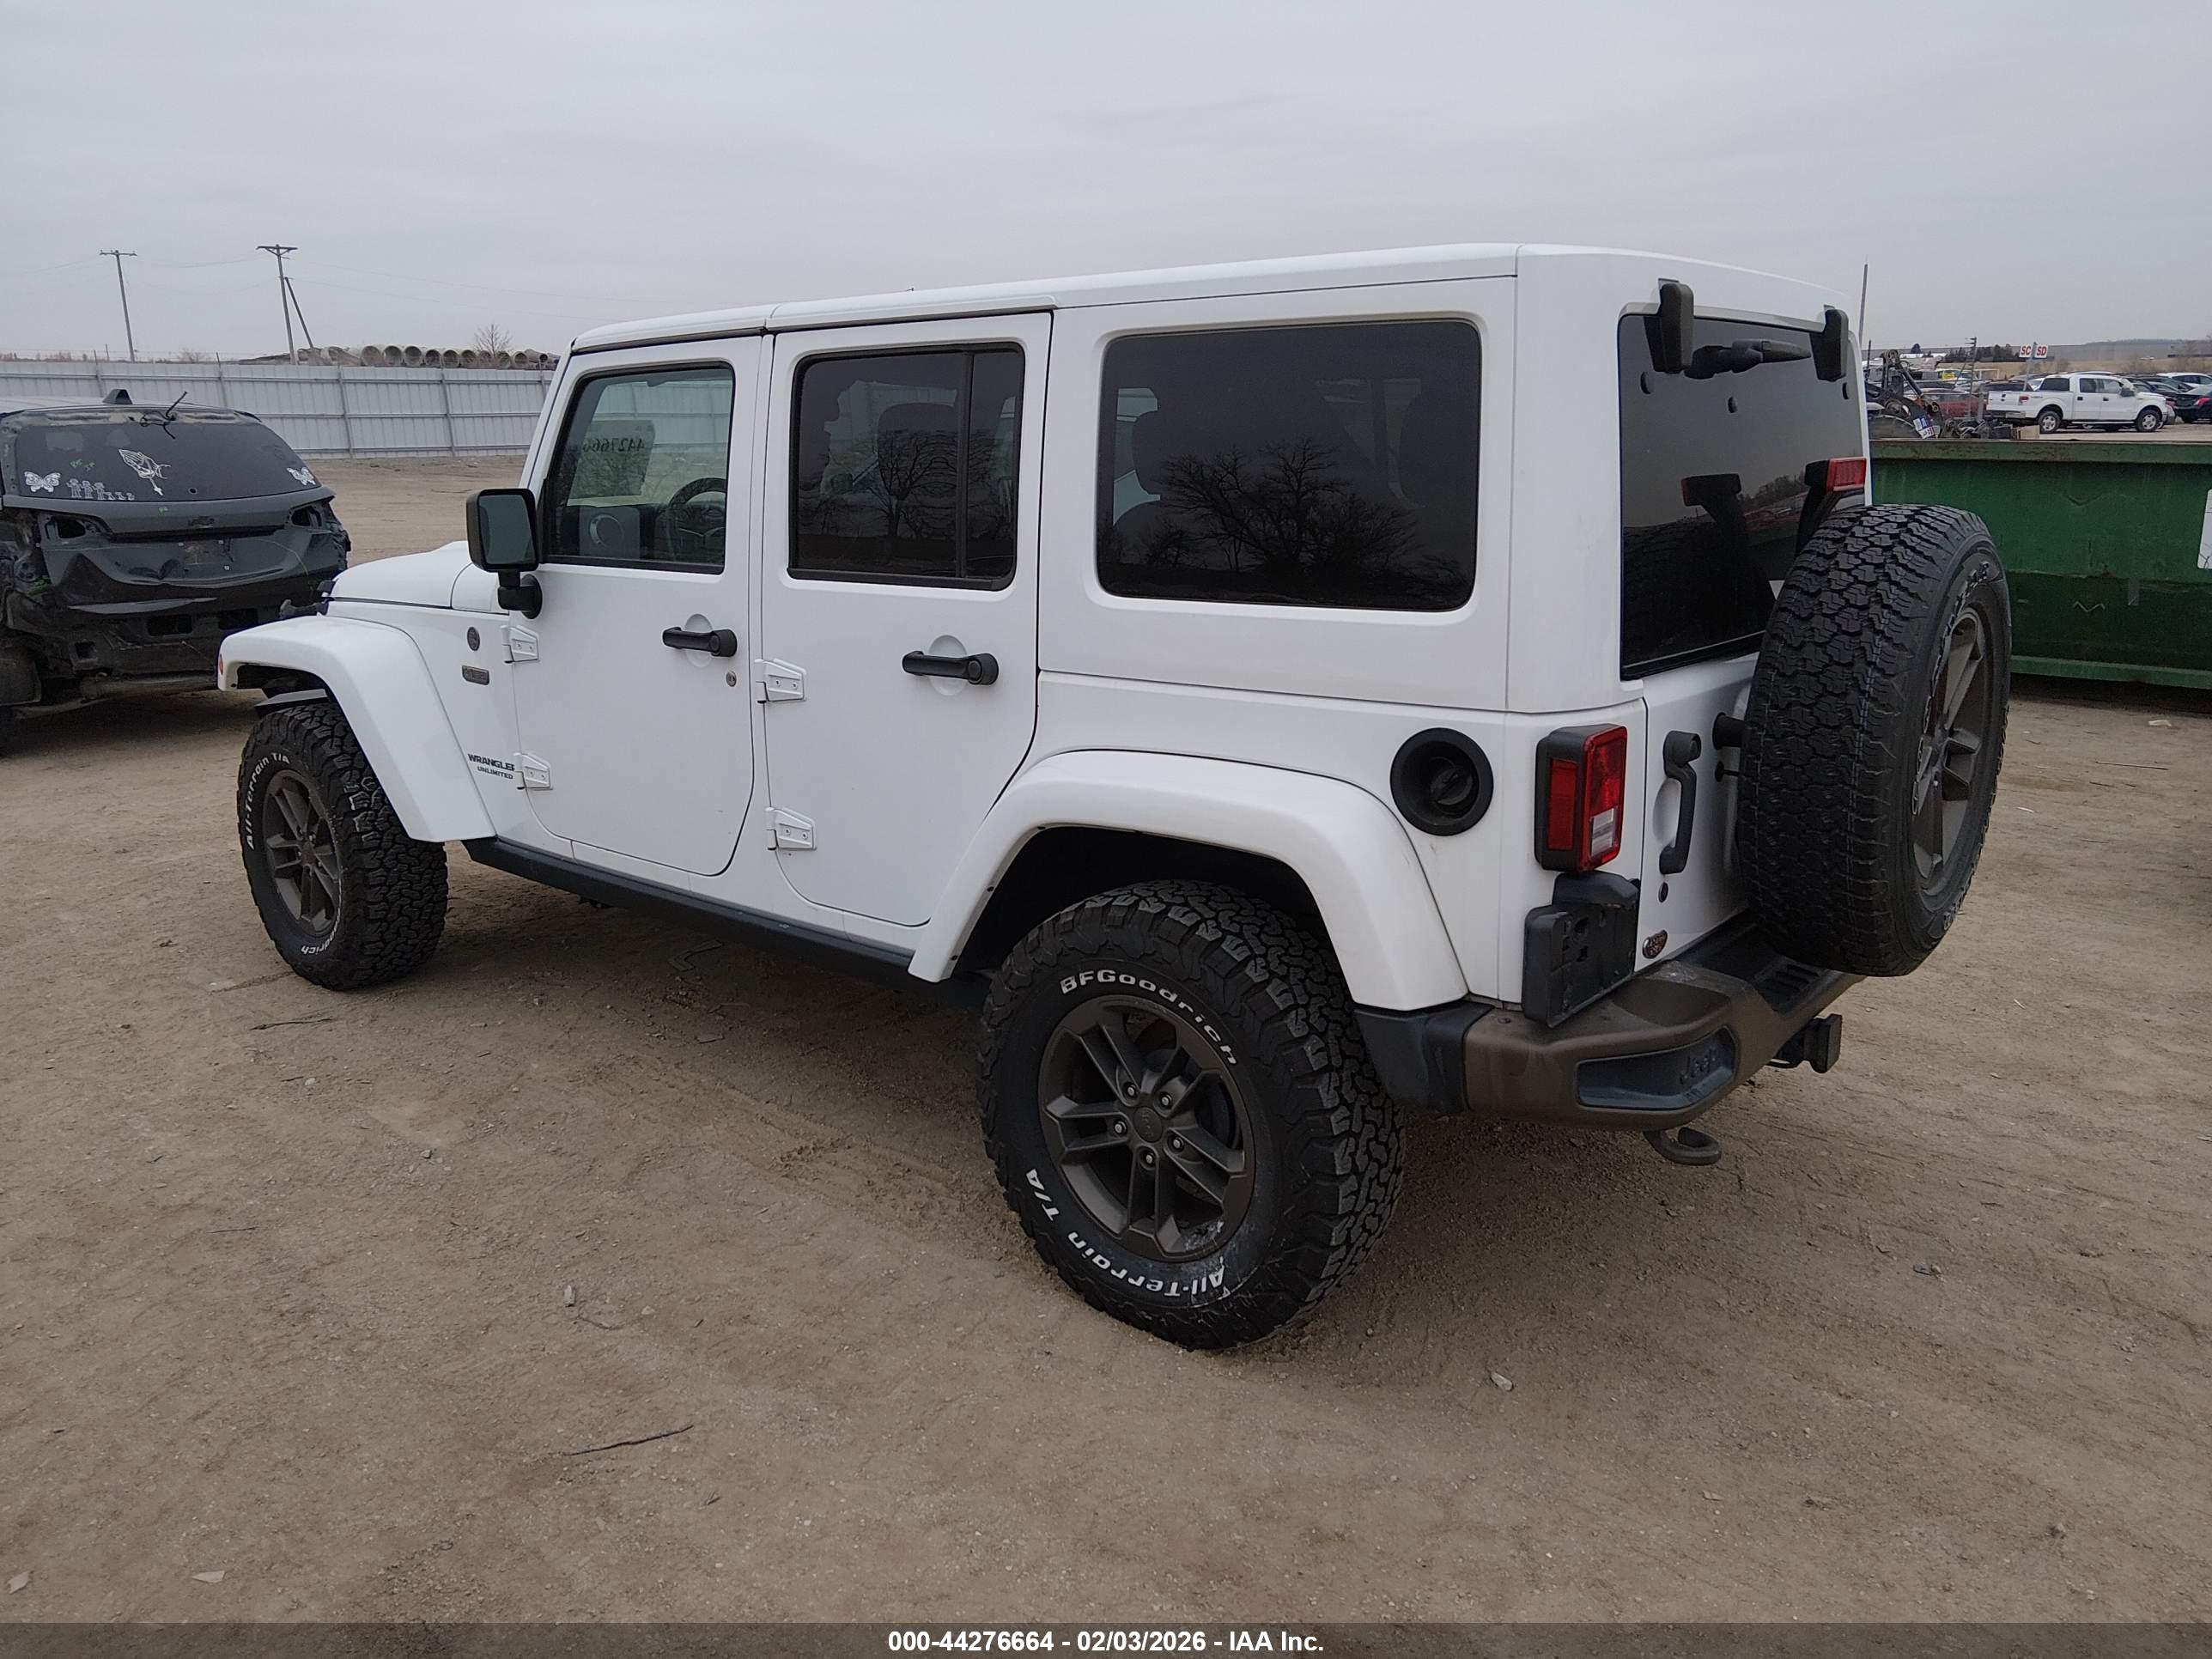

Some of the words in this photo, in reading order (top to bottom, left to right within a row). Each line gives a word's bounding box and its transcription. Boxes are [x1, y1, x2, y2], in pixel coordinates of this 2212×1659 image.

[2021, 345, 2032, 356] SC
[2036, 345, 2047, 356] SD
[477, 766, 514, 780] UNLIMITED
[245, 757, 270, 850] All-Terrain
[270, 752, 290, 764] T/A
[1060, 969, 1237, 1064] BFGoodrich
[1026, 1169, 1060, 1222] T/A
[1067, 1231, 1225, 1297] All-Terrain
